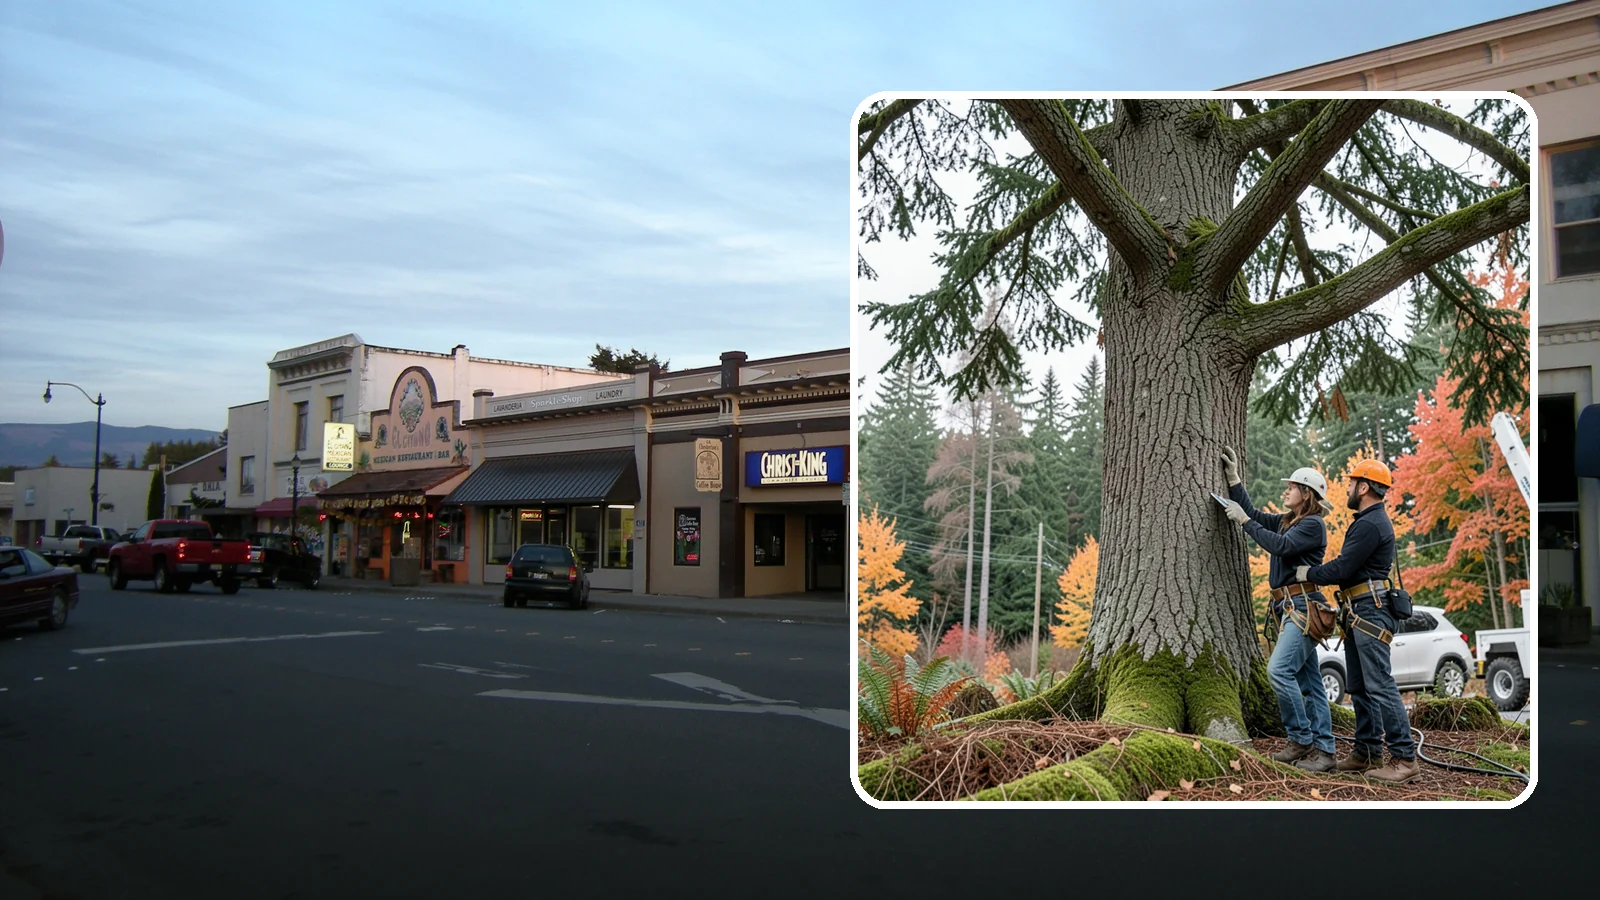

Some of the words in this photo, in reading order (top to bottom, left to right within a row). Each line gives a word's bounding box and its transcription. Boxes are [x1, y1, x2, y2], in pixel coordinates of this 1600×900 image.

[493, 402, 522, 413] LAVANDERIA
[562, 394, 583, 405] Shop
[595, 389, 624, 400] LAUNDRY
[373, 455, 396, 464] MEXICAN
[397, 451, 434, 463] RESTAURANT
[437, 450, 450, 459] BAR
[761, 452, 797, 478] CHRIST
[799, 450, 827, 476] KING
